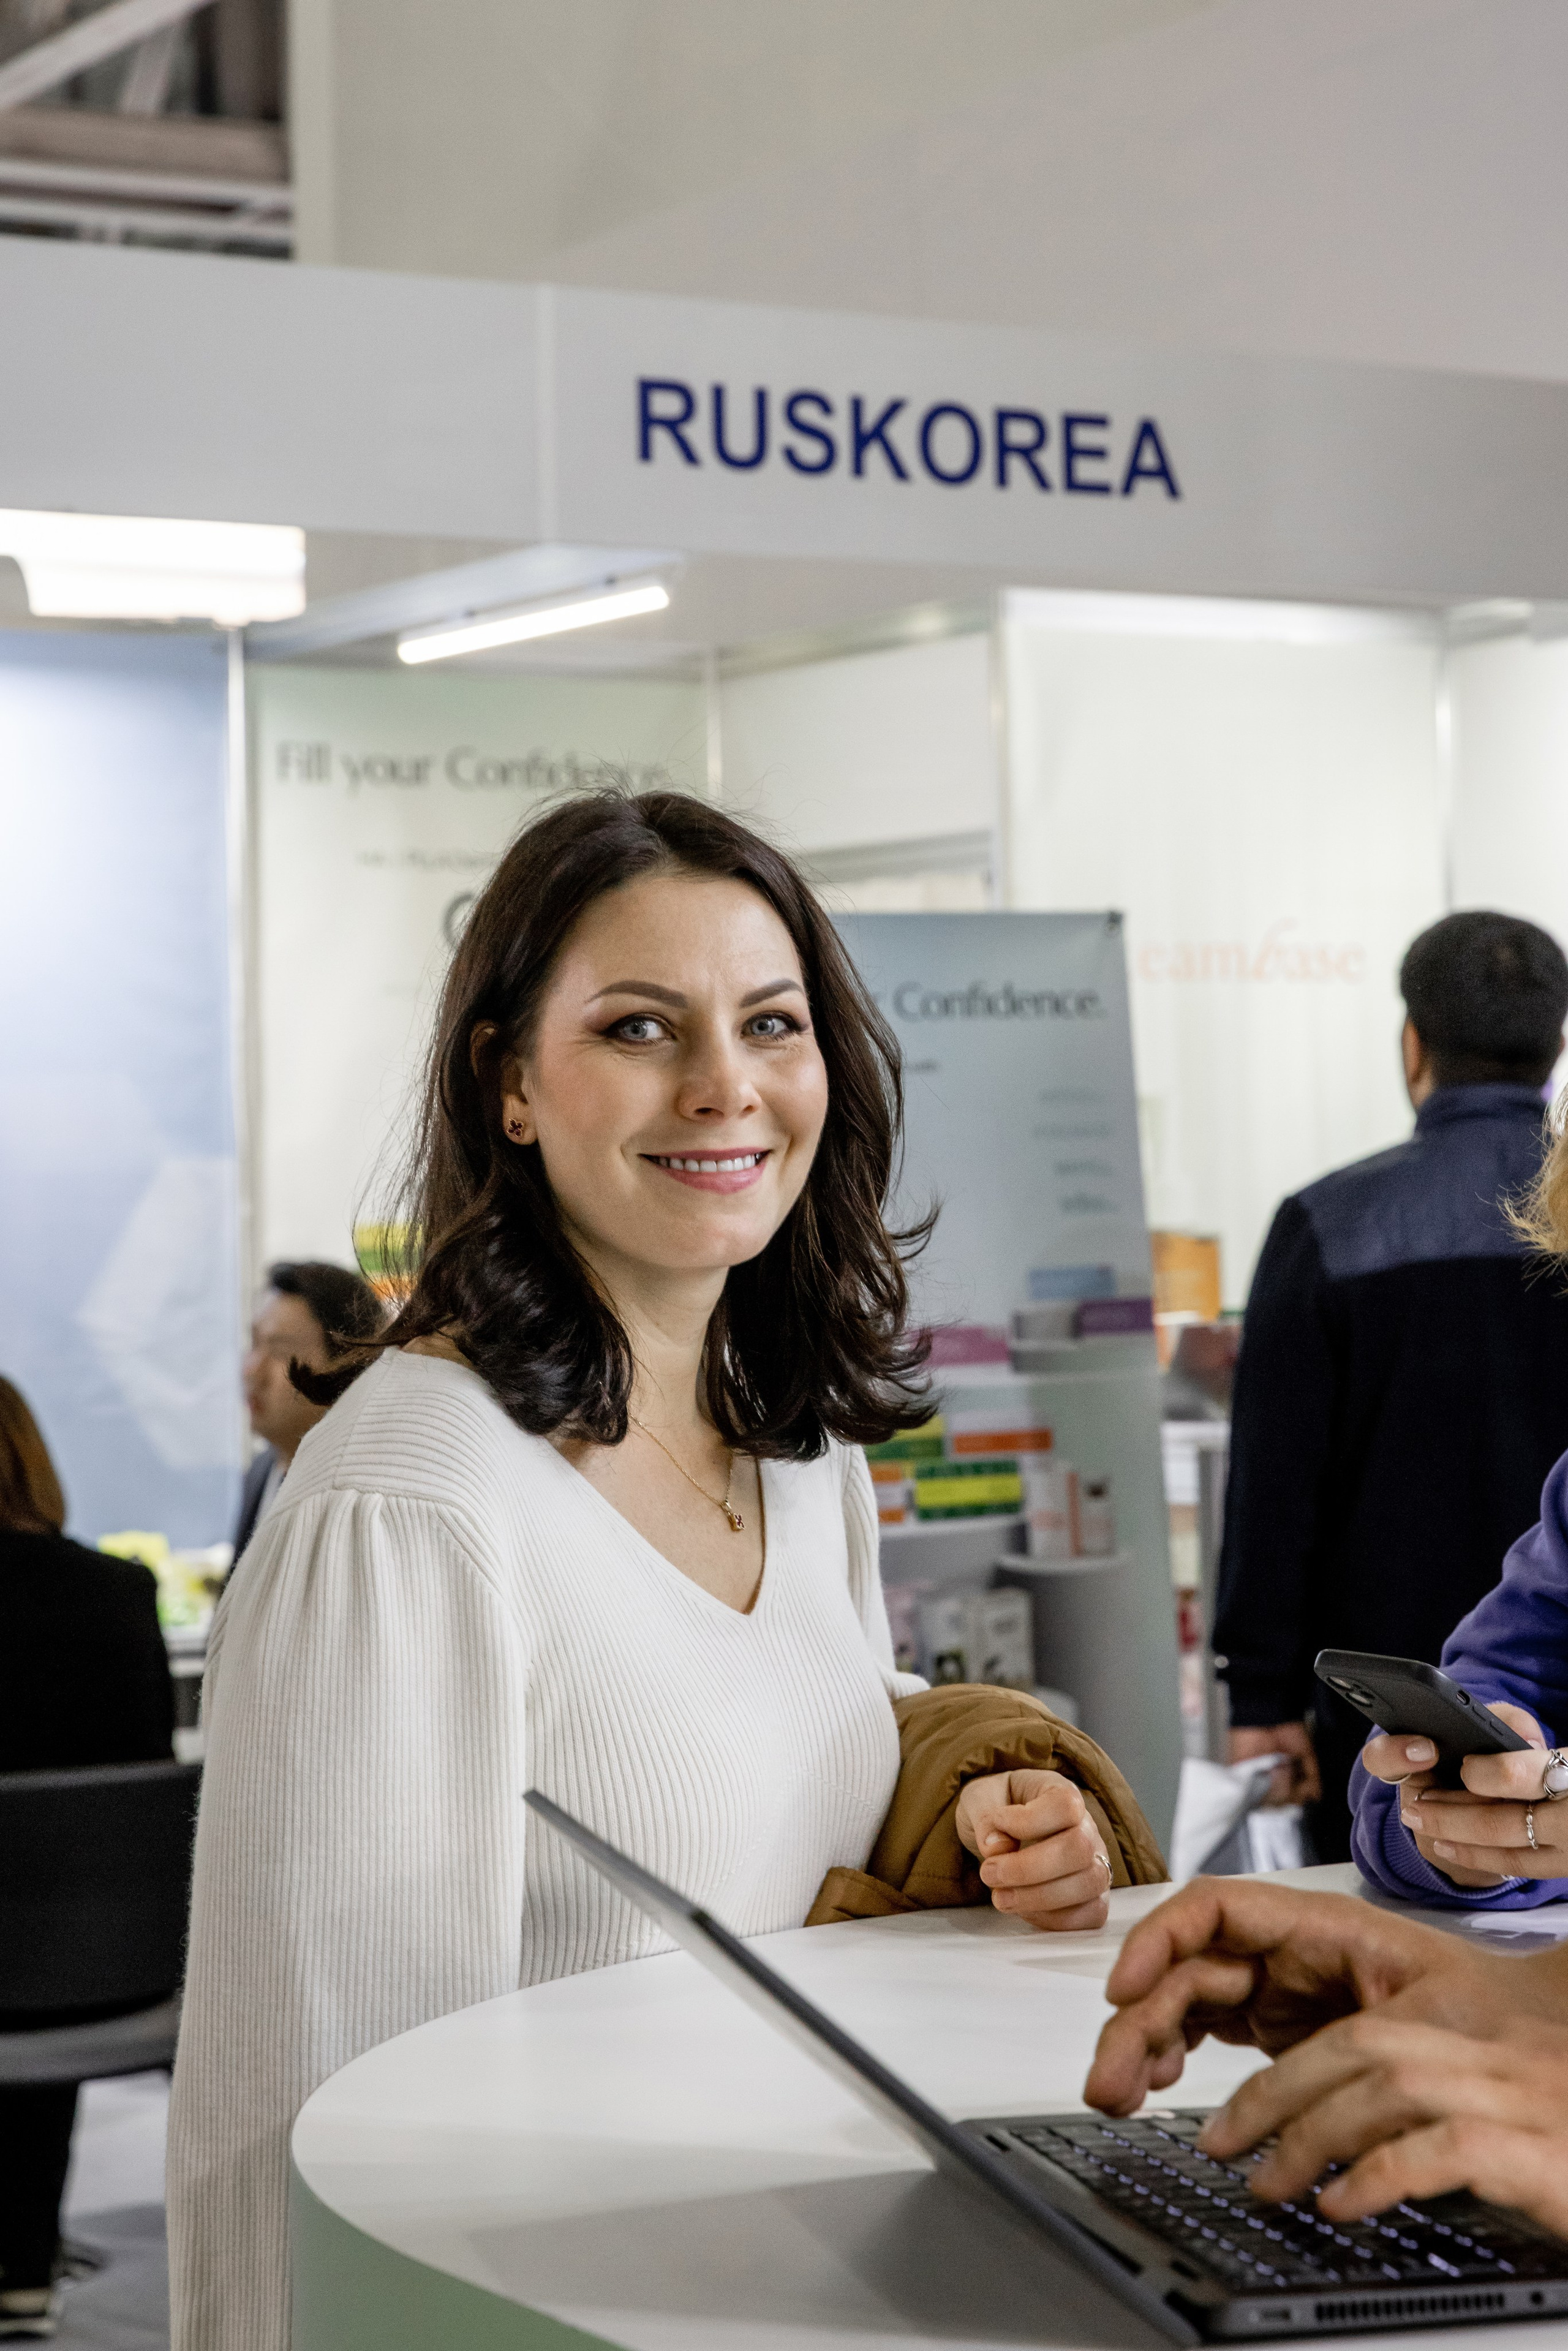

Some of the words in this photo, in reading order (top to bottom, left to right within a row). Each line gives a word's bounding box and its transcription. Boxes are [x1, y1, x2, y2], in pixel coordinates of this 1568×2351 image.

[636, 375, 1182, 500] RUSKOREA
[276, 742, 331, 784] Fill
[340, 754, 434, 796] your
